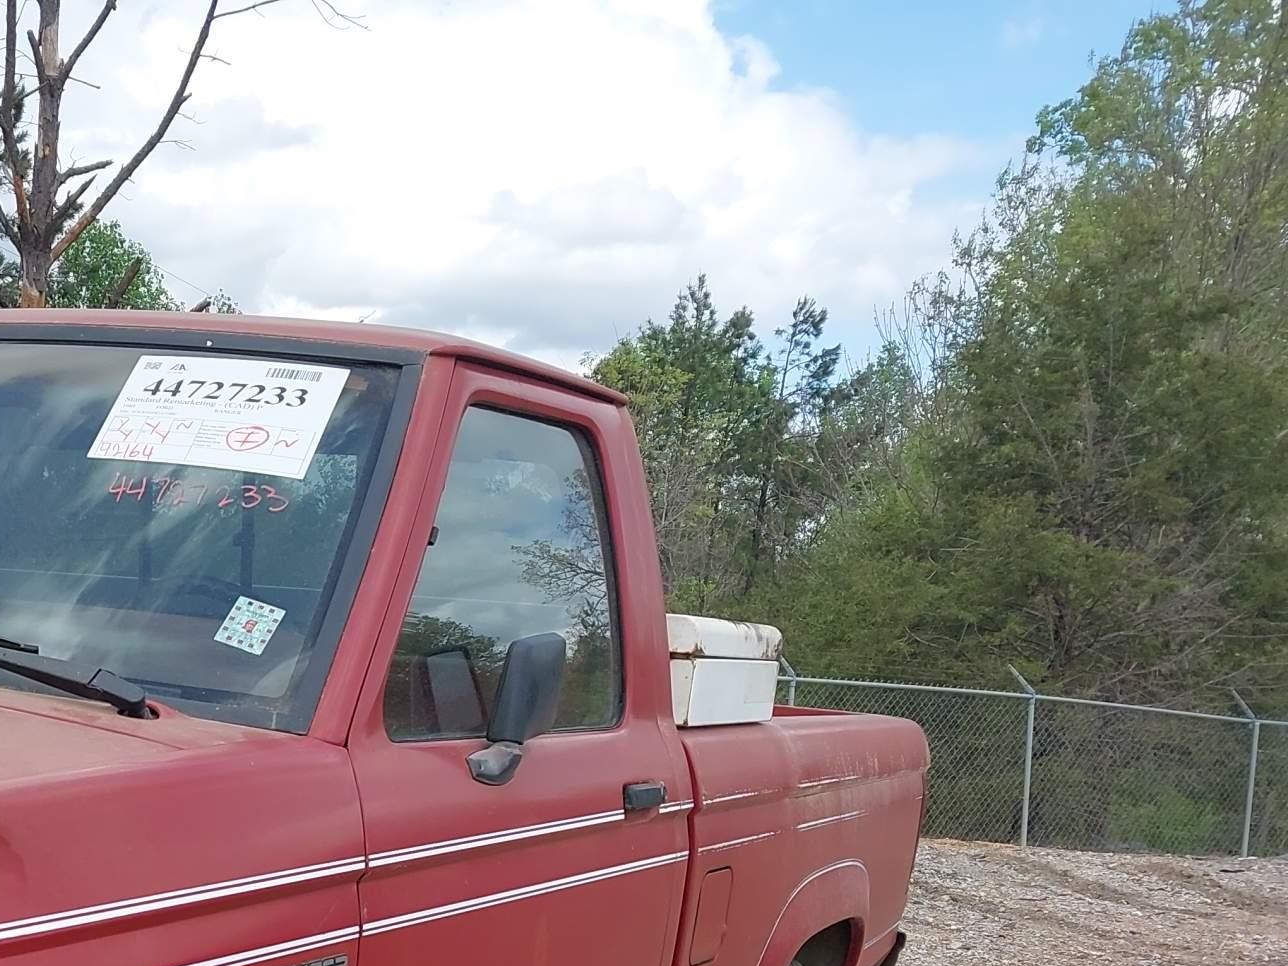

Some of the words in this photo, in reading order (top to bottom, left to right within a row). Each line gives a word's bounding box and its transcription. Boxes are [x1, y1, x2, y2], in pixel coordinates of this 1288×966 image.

[125, 395, 162, 404] Standard
[163, 397, 217, 408] Remarketing
[143, 377, 309, 408] 44727233
